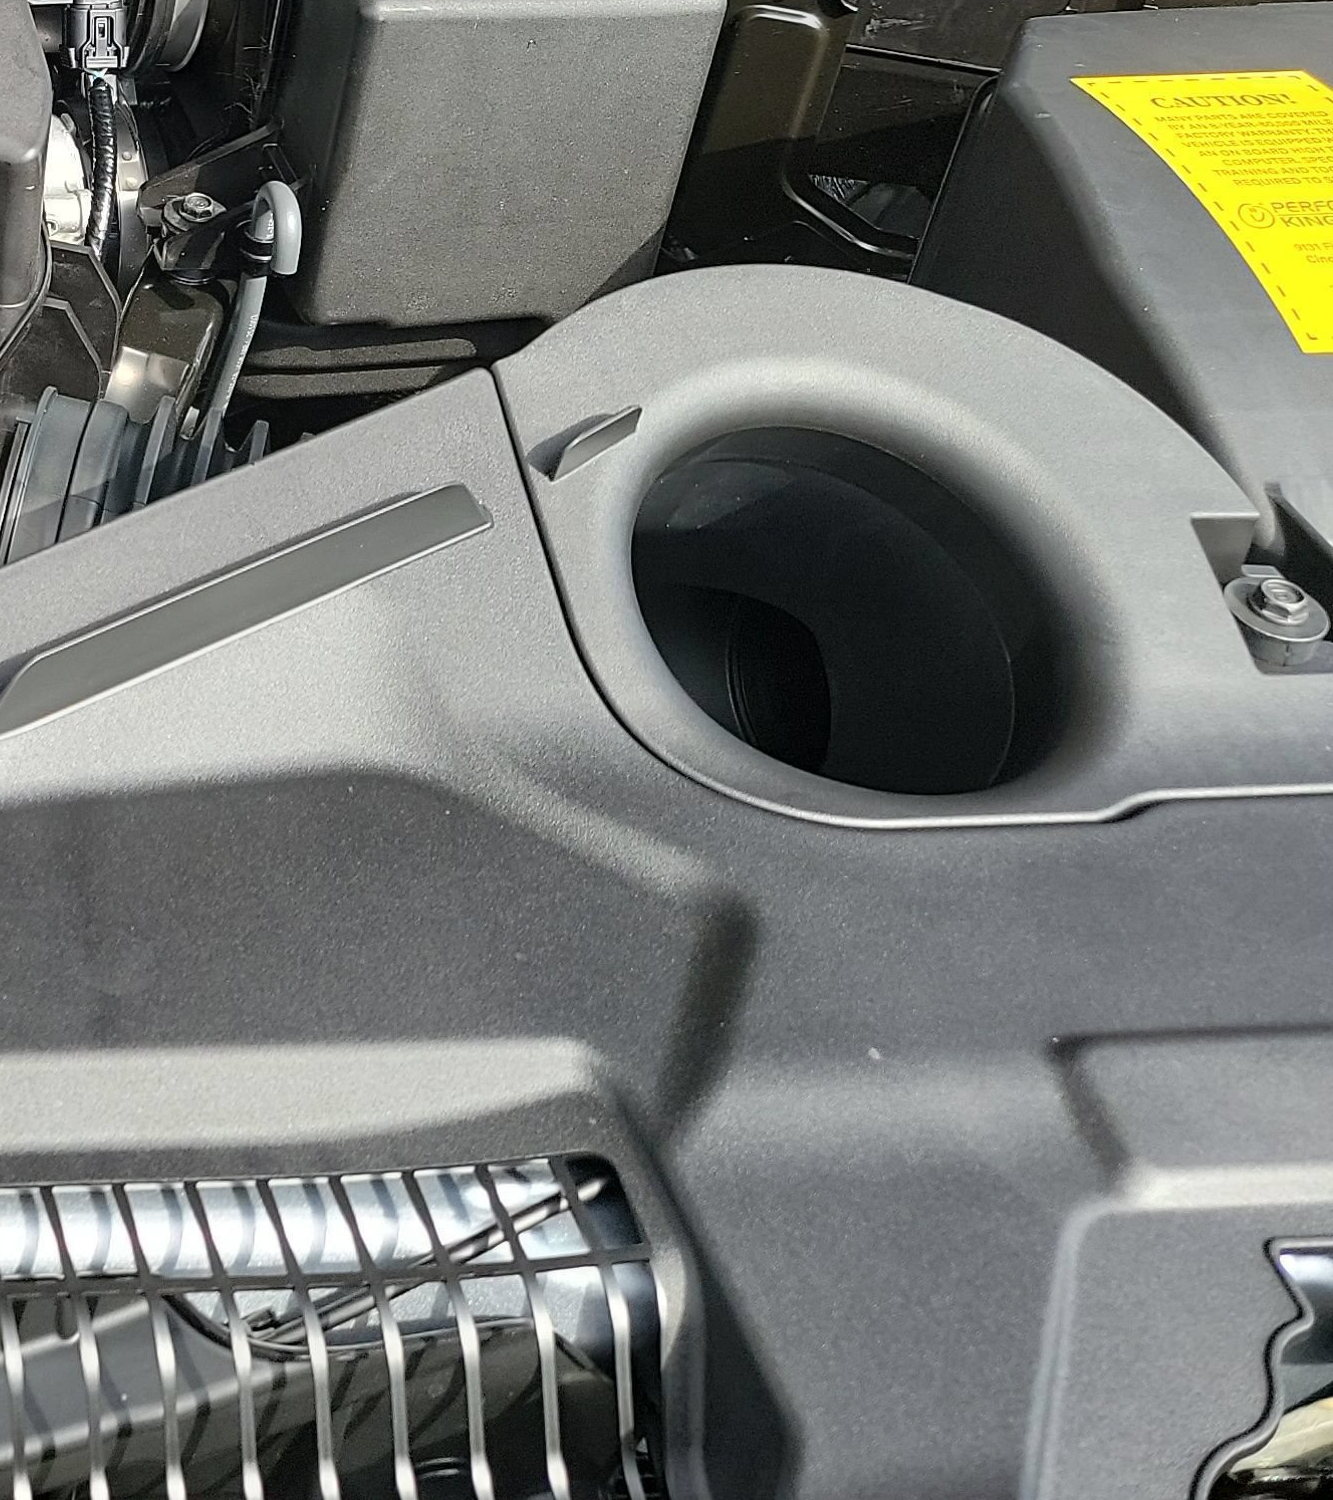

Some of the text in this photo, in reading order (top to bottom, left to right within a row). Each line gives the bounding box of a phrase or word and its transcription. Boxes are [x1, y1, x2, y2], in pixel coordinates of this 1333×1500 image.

[1150, 93, 1297, 109] CAUTION!
[1194, 113, 1237, 121] PARTS
[1266, 110, 1328, 118] COVERED
[1174, 130, 1236, 139] FACTORY
[1181, 139, 1238, 148] VEHICLE
[1254, 137, 1322, 146] EQUIPPED
[1241, 147, 1289, 156] BOARD
[1289, 146, 1326, 154] HIGH
[1212, 168, 1279, 177] TRAINING
[1280, 167, 1310, 175] AND
[1232, 177, 1302, 187] REQUIRED
[1301, 176, 1322, 184] TO
